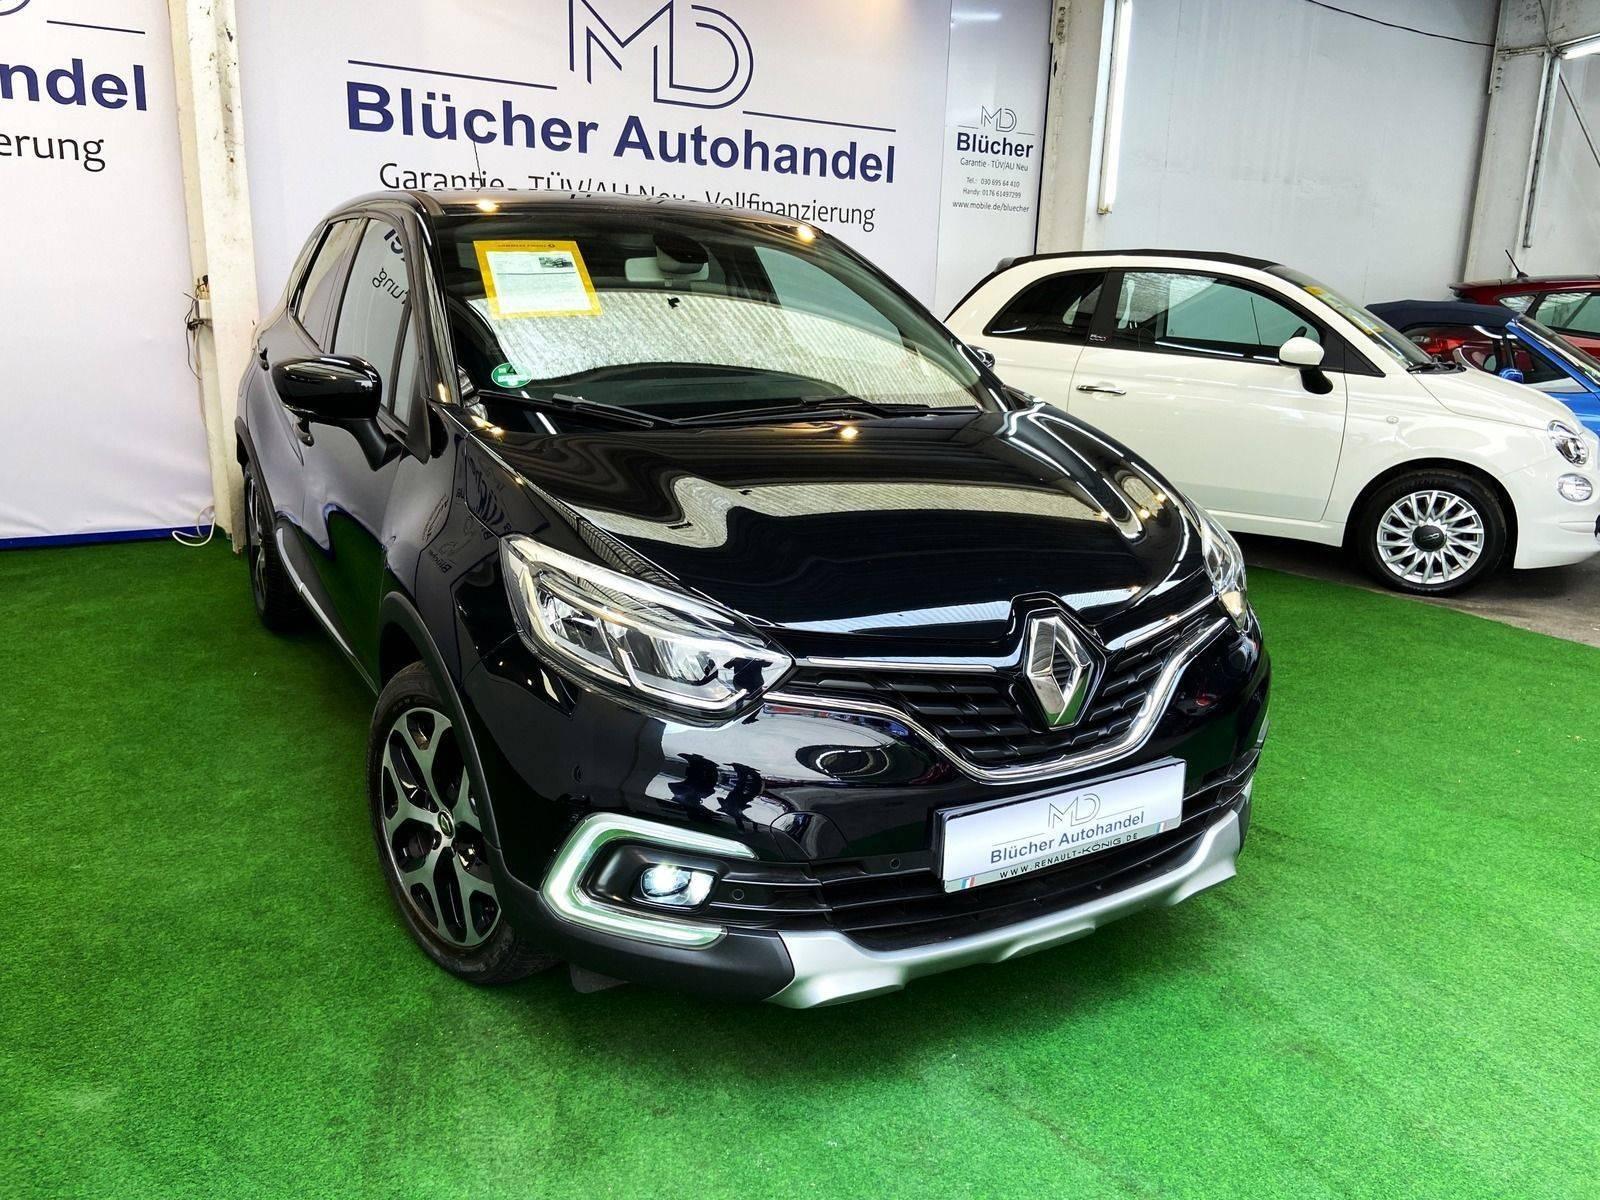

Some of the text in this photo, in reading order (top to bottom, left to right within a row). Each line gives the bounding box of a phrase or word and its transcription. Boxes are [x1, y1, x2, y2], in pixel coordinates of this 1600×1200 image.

[346, 81, 896, 184] Blücher Autohandel
[957, 132, 1034, 158] Blücher
[960, 157, 986, 168] Garantie
[1016, 163, 1029, 172] Neu
[990, 811, 1145, 864] Blücher Autohandel
